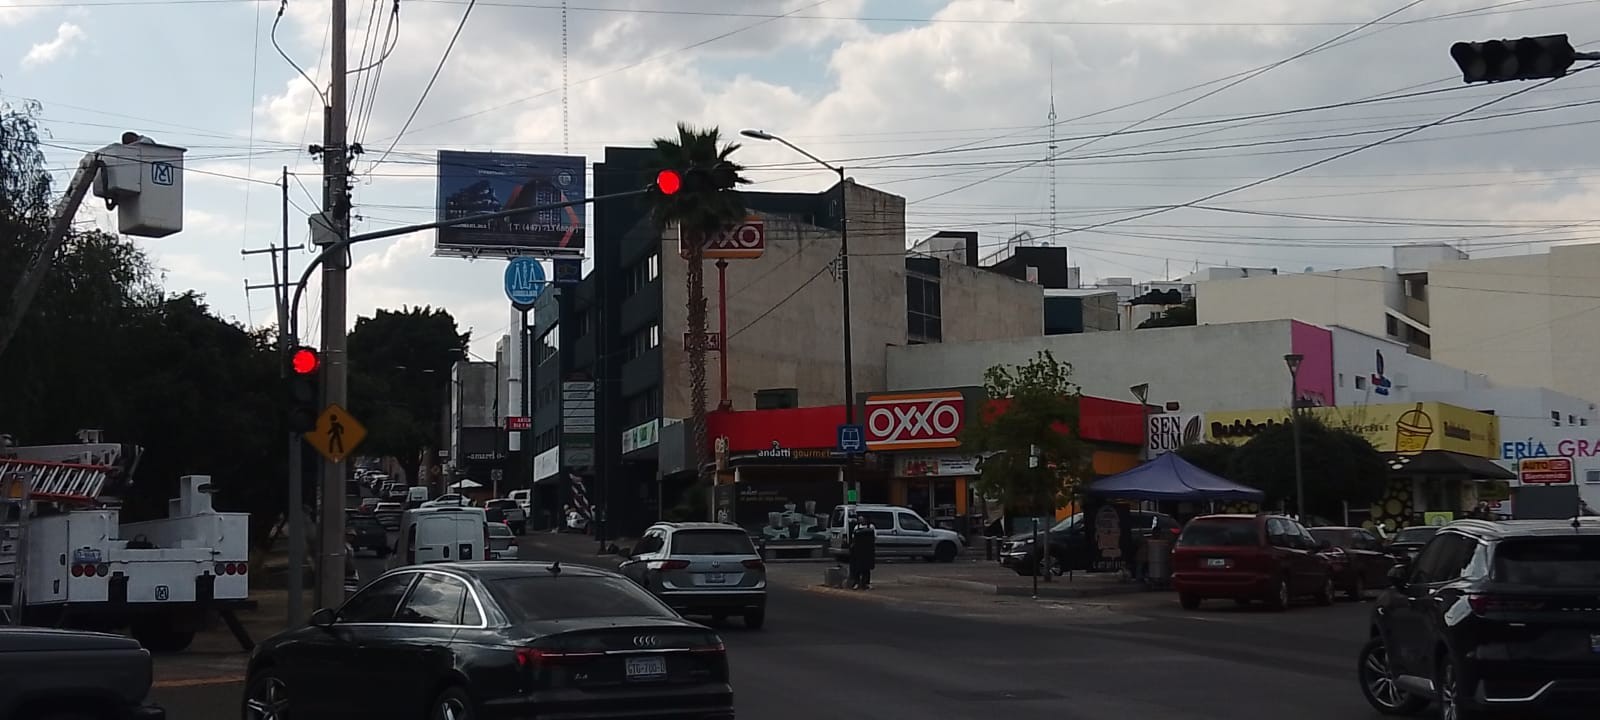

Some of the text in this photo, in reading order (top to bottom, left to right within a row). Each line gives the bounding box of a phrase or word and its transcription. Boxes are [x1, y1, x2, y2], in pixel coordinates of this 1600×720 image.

[869, 400, 960, 442] OXXO
[1151, 416, 1180, 434] SEN
[1151, 433, 1180, 450] SUM
[1500, 437, 1547, 459] ERÍA
[758, 447, 791, 458] andatti
